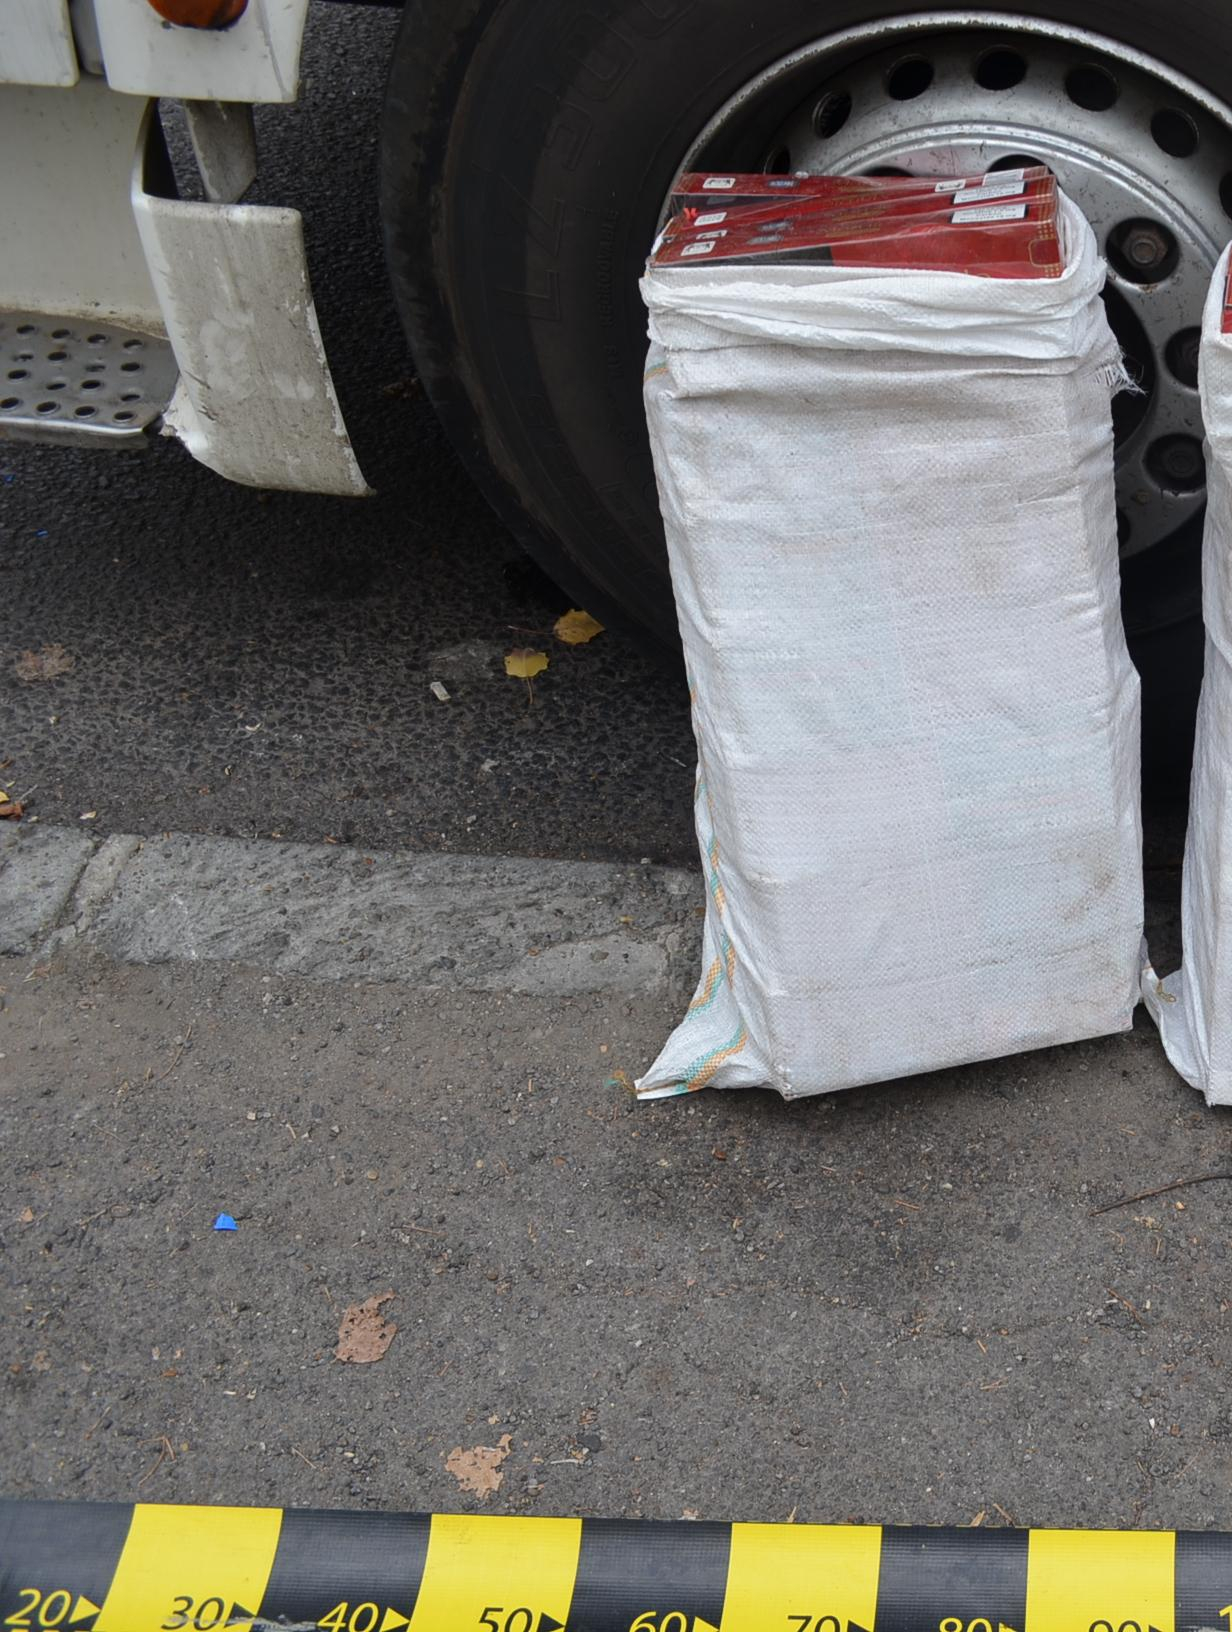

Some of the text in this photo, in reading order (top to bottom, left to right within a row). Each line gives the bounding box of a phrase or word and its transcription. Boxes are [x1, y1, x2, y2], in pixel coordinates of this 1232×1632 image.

[4, 1588, 73, 1627] 20
[160, 1595, 226, 1632] 30
[316, 1601, 380, 1632] 40
[478, 1606, 534, 1632] 50
